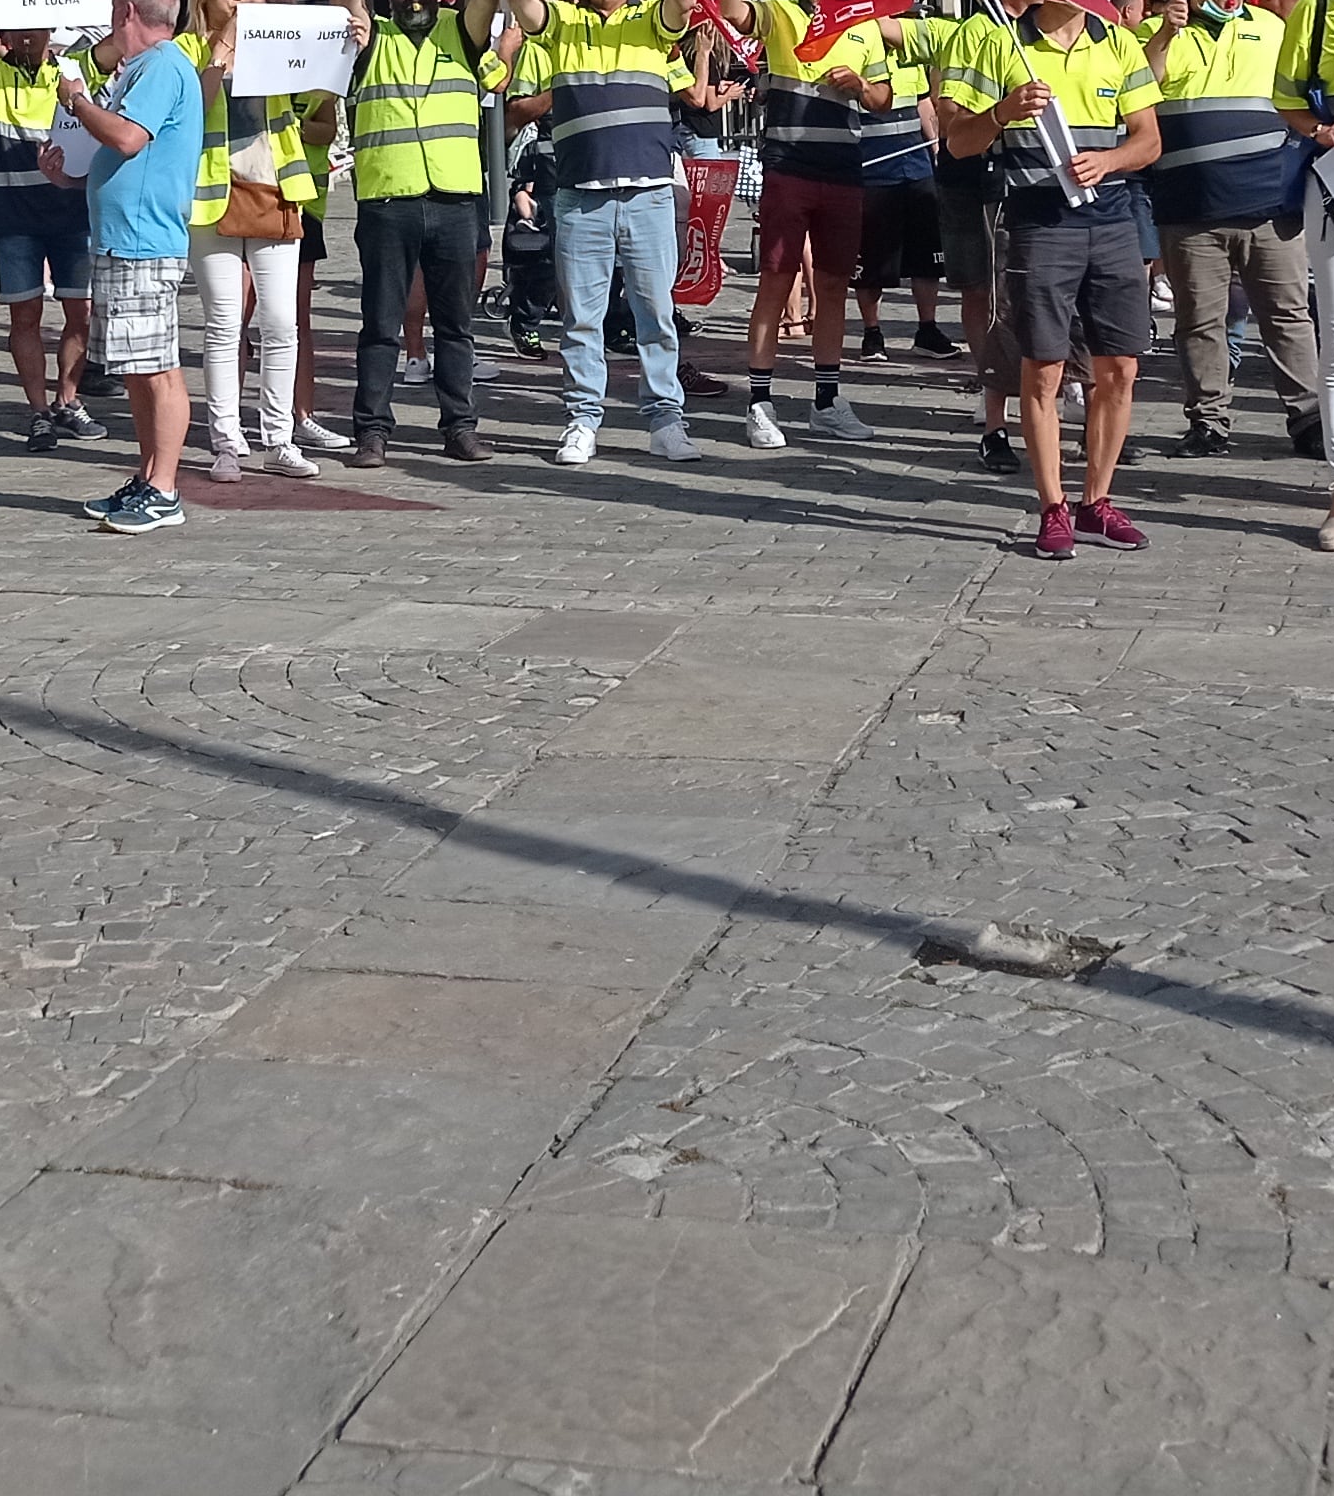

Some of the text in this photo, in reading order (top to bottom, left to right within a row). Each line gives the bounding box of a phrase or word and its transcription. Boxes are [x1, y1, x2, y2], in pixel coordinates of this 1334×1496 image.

[243, 29, 349, 41] ¡SALARIOS JUSTO
[288, 59, 306, 69] YA!
